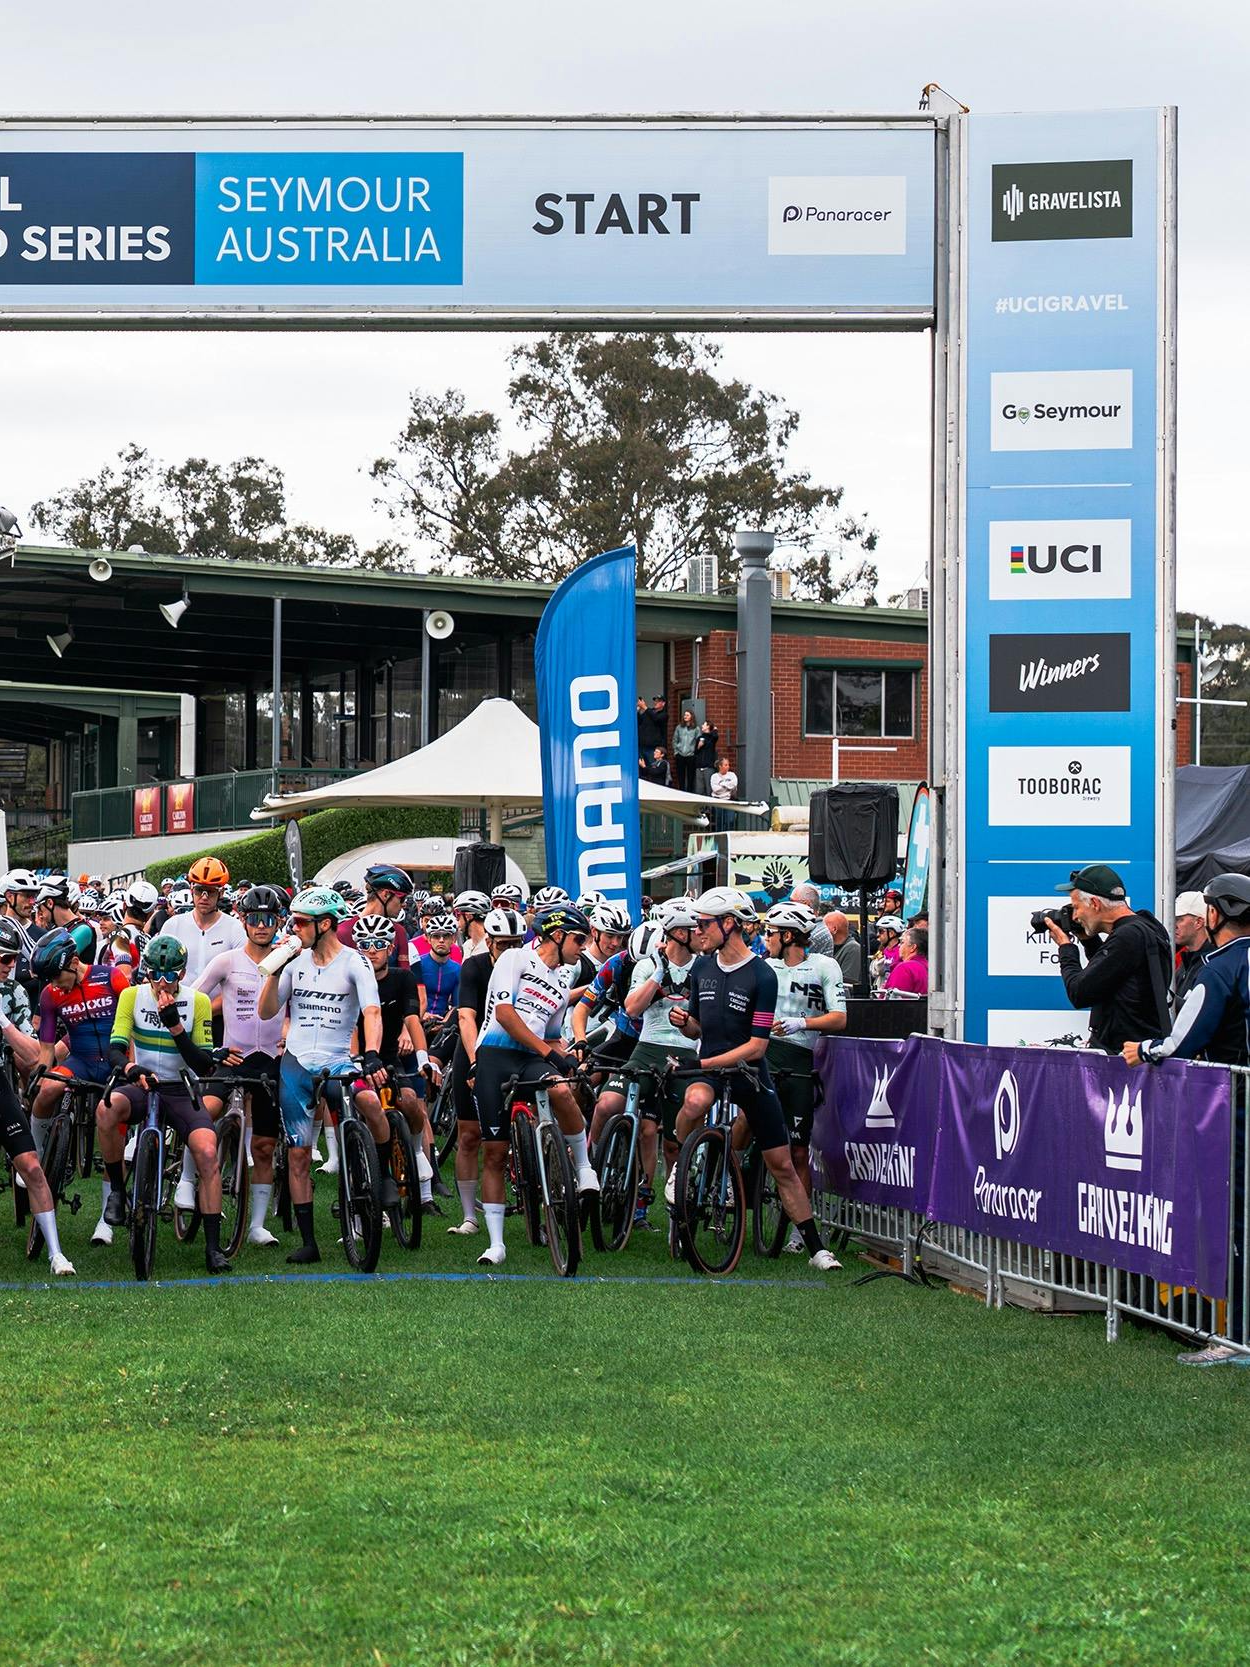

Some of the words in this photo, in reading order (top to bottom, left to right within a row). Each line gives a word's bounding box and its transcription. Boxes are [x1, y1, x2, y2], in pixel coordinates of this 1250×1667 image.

[216, 175, 430, 213] SEYMOUR
[1028, 188, 1122, 212] GRAVELISTA
[531, 192, 701, 236] START
[805, 206, 892, 222] Panaracer
[19, 225, 171, 262] SERIES
[215, 226, 442, 262] AUSTRALIA
[995, 294, 1129, 314] #UCIGRAVEL
[1033, 403, 1121, 421] Seymour
[1027, 544, 1102, 574] UCI
[1018, 653, 1101, 692] Winners
[569, 674, 627, 909] MANO
[1017, 777, 1101, 795] TOOBORAC
[1040, 950, 1060, 964] Fo
[292, 988, 350, 1002] GIANT
[520, 972, 565, 1001] GIANT
[522, 987, 559, 1010] SRAM
[61, 996, 113, 1016] MAXXIS
[298, 1002, 342, 1014] SHIMANO
[973, 1165, 1042, 1223] Panaracer
